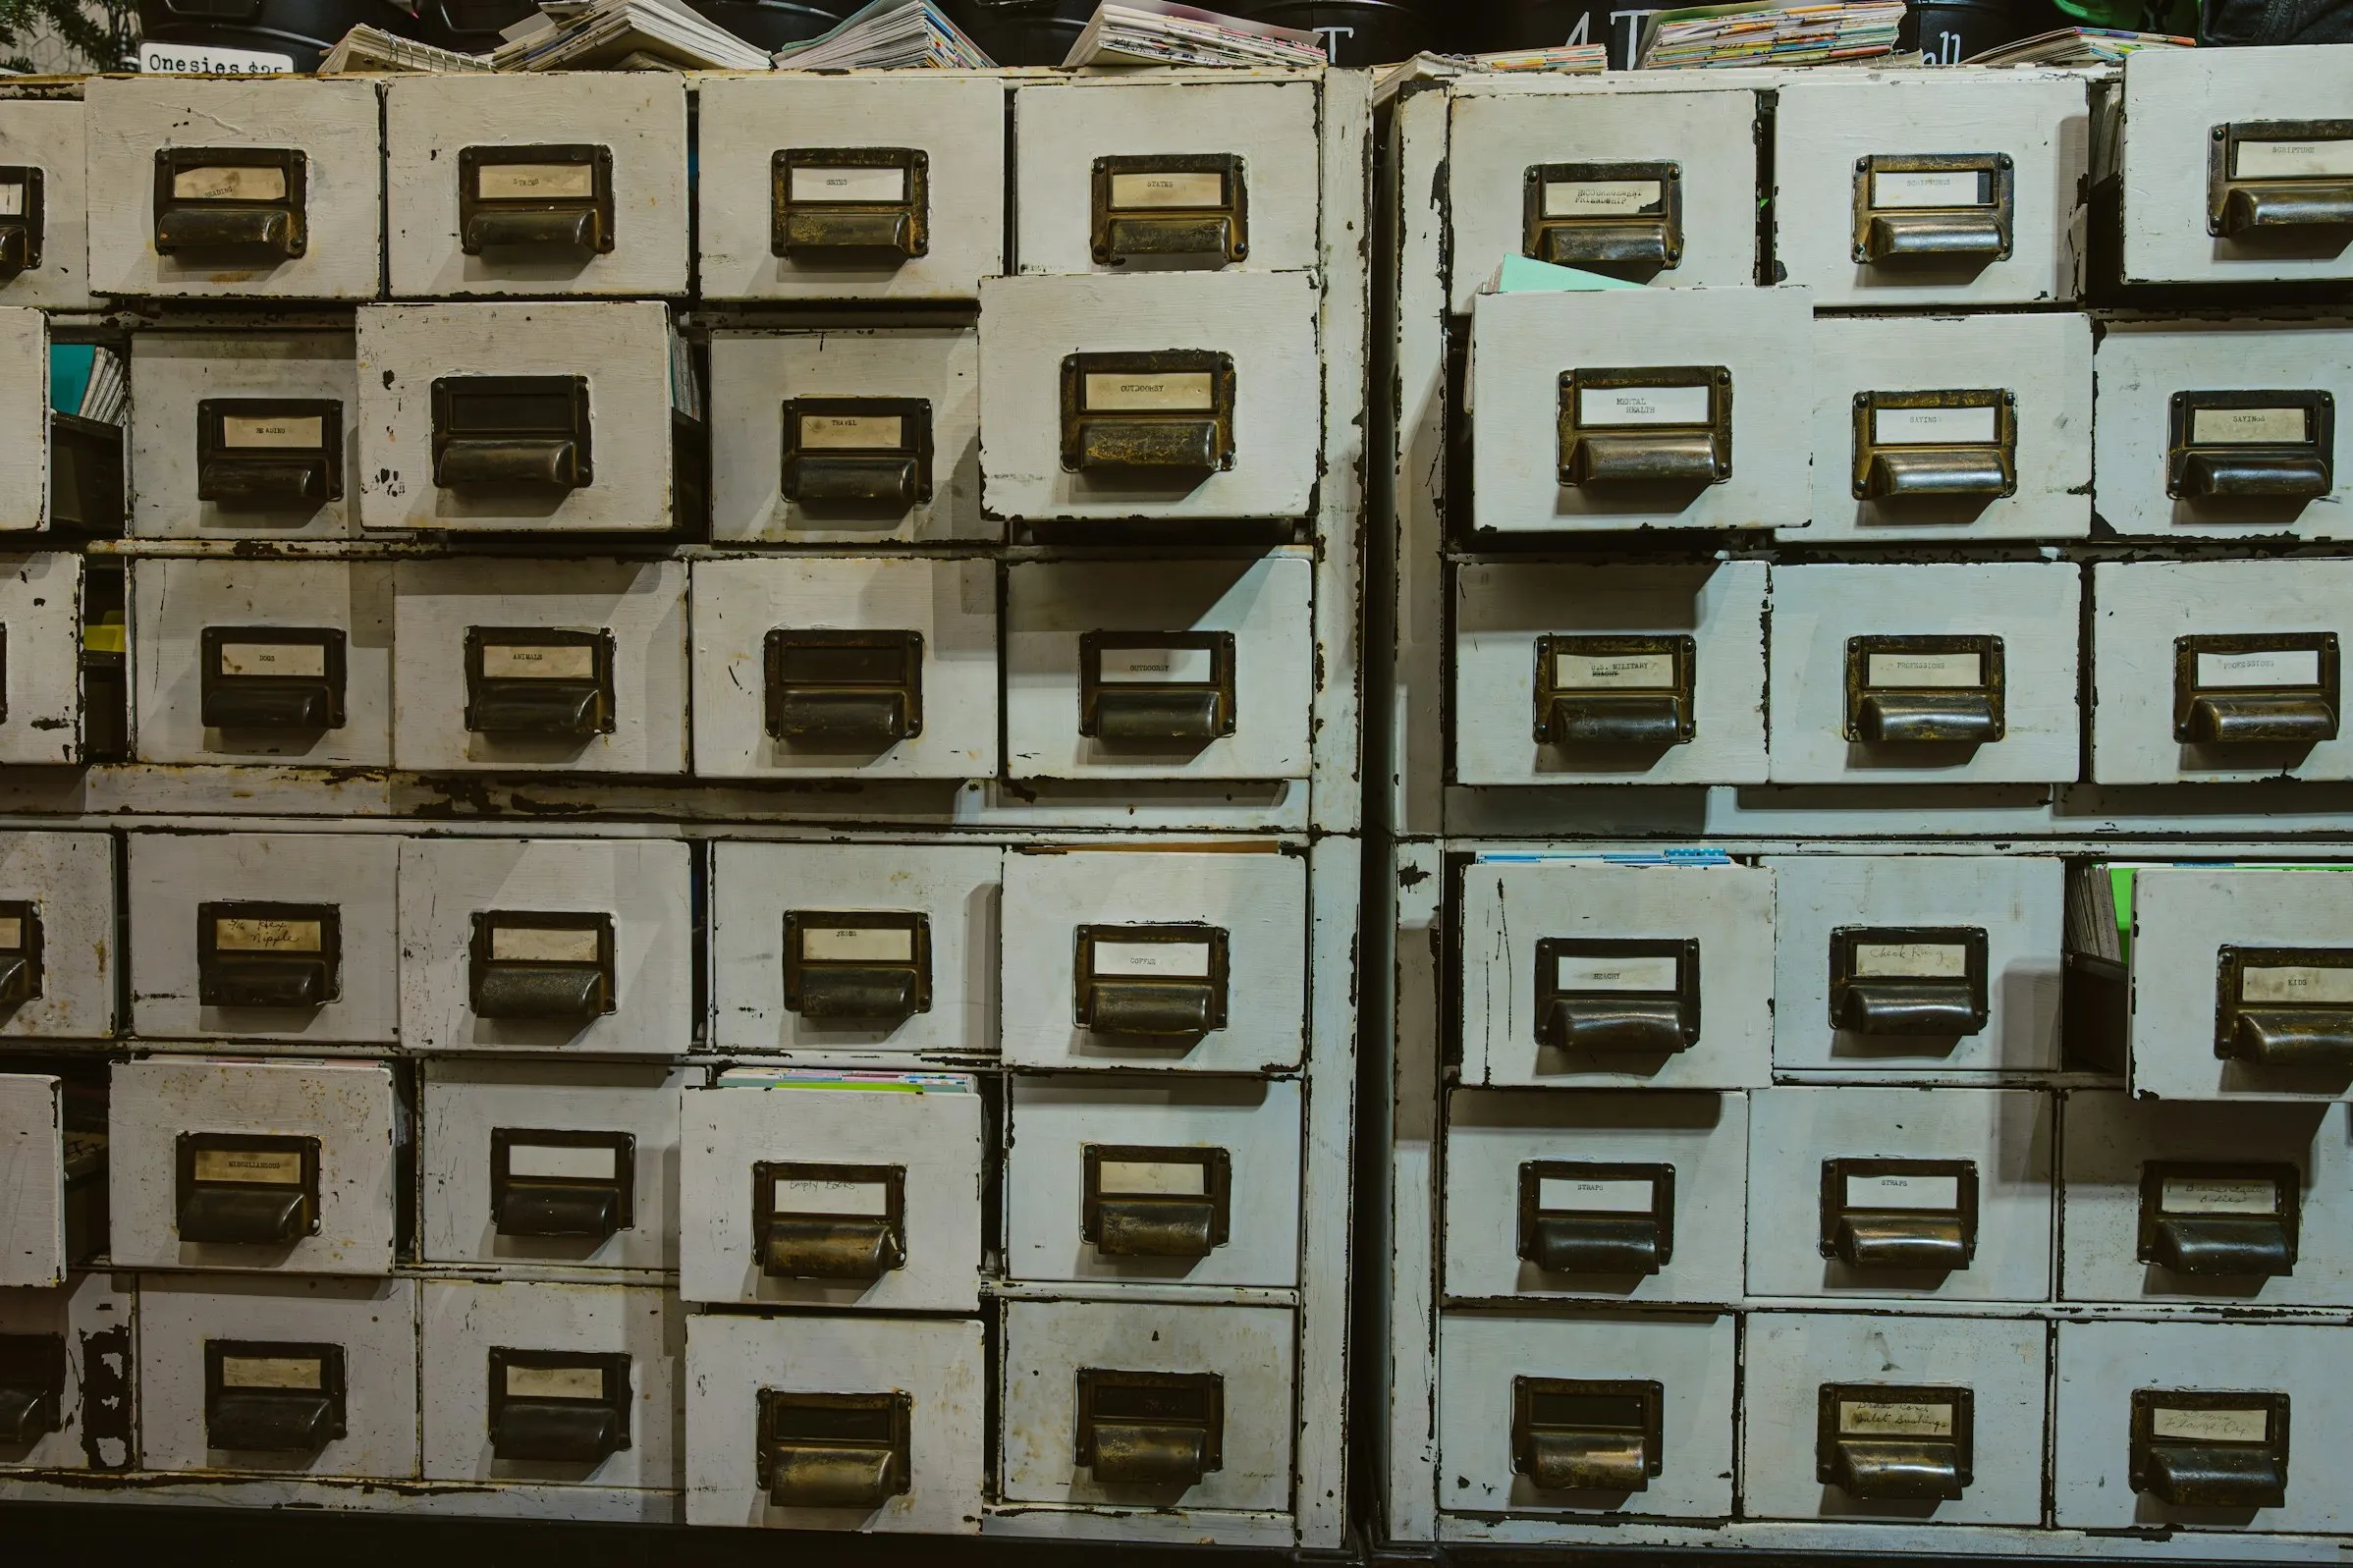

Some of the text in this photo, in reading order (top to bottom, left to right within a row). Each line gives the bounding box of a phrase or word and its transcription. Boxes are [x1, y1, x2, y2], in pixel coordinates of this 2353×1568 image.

[149, 54, 240, 74] Onesies
[2223, 661, 2274, 670] PROFESSIONS
[250, 930, 300, 947] Nipple
[790, 1179, 819, 1193] Empty
